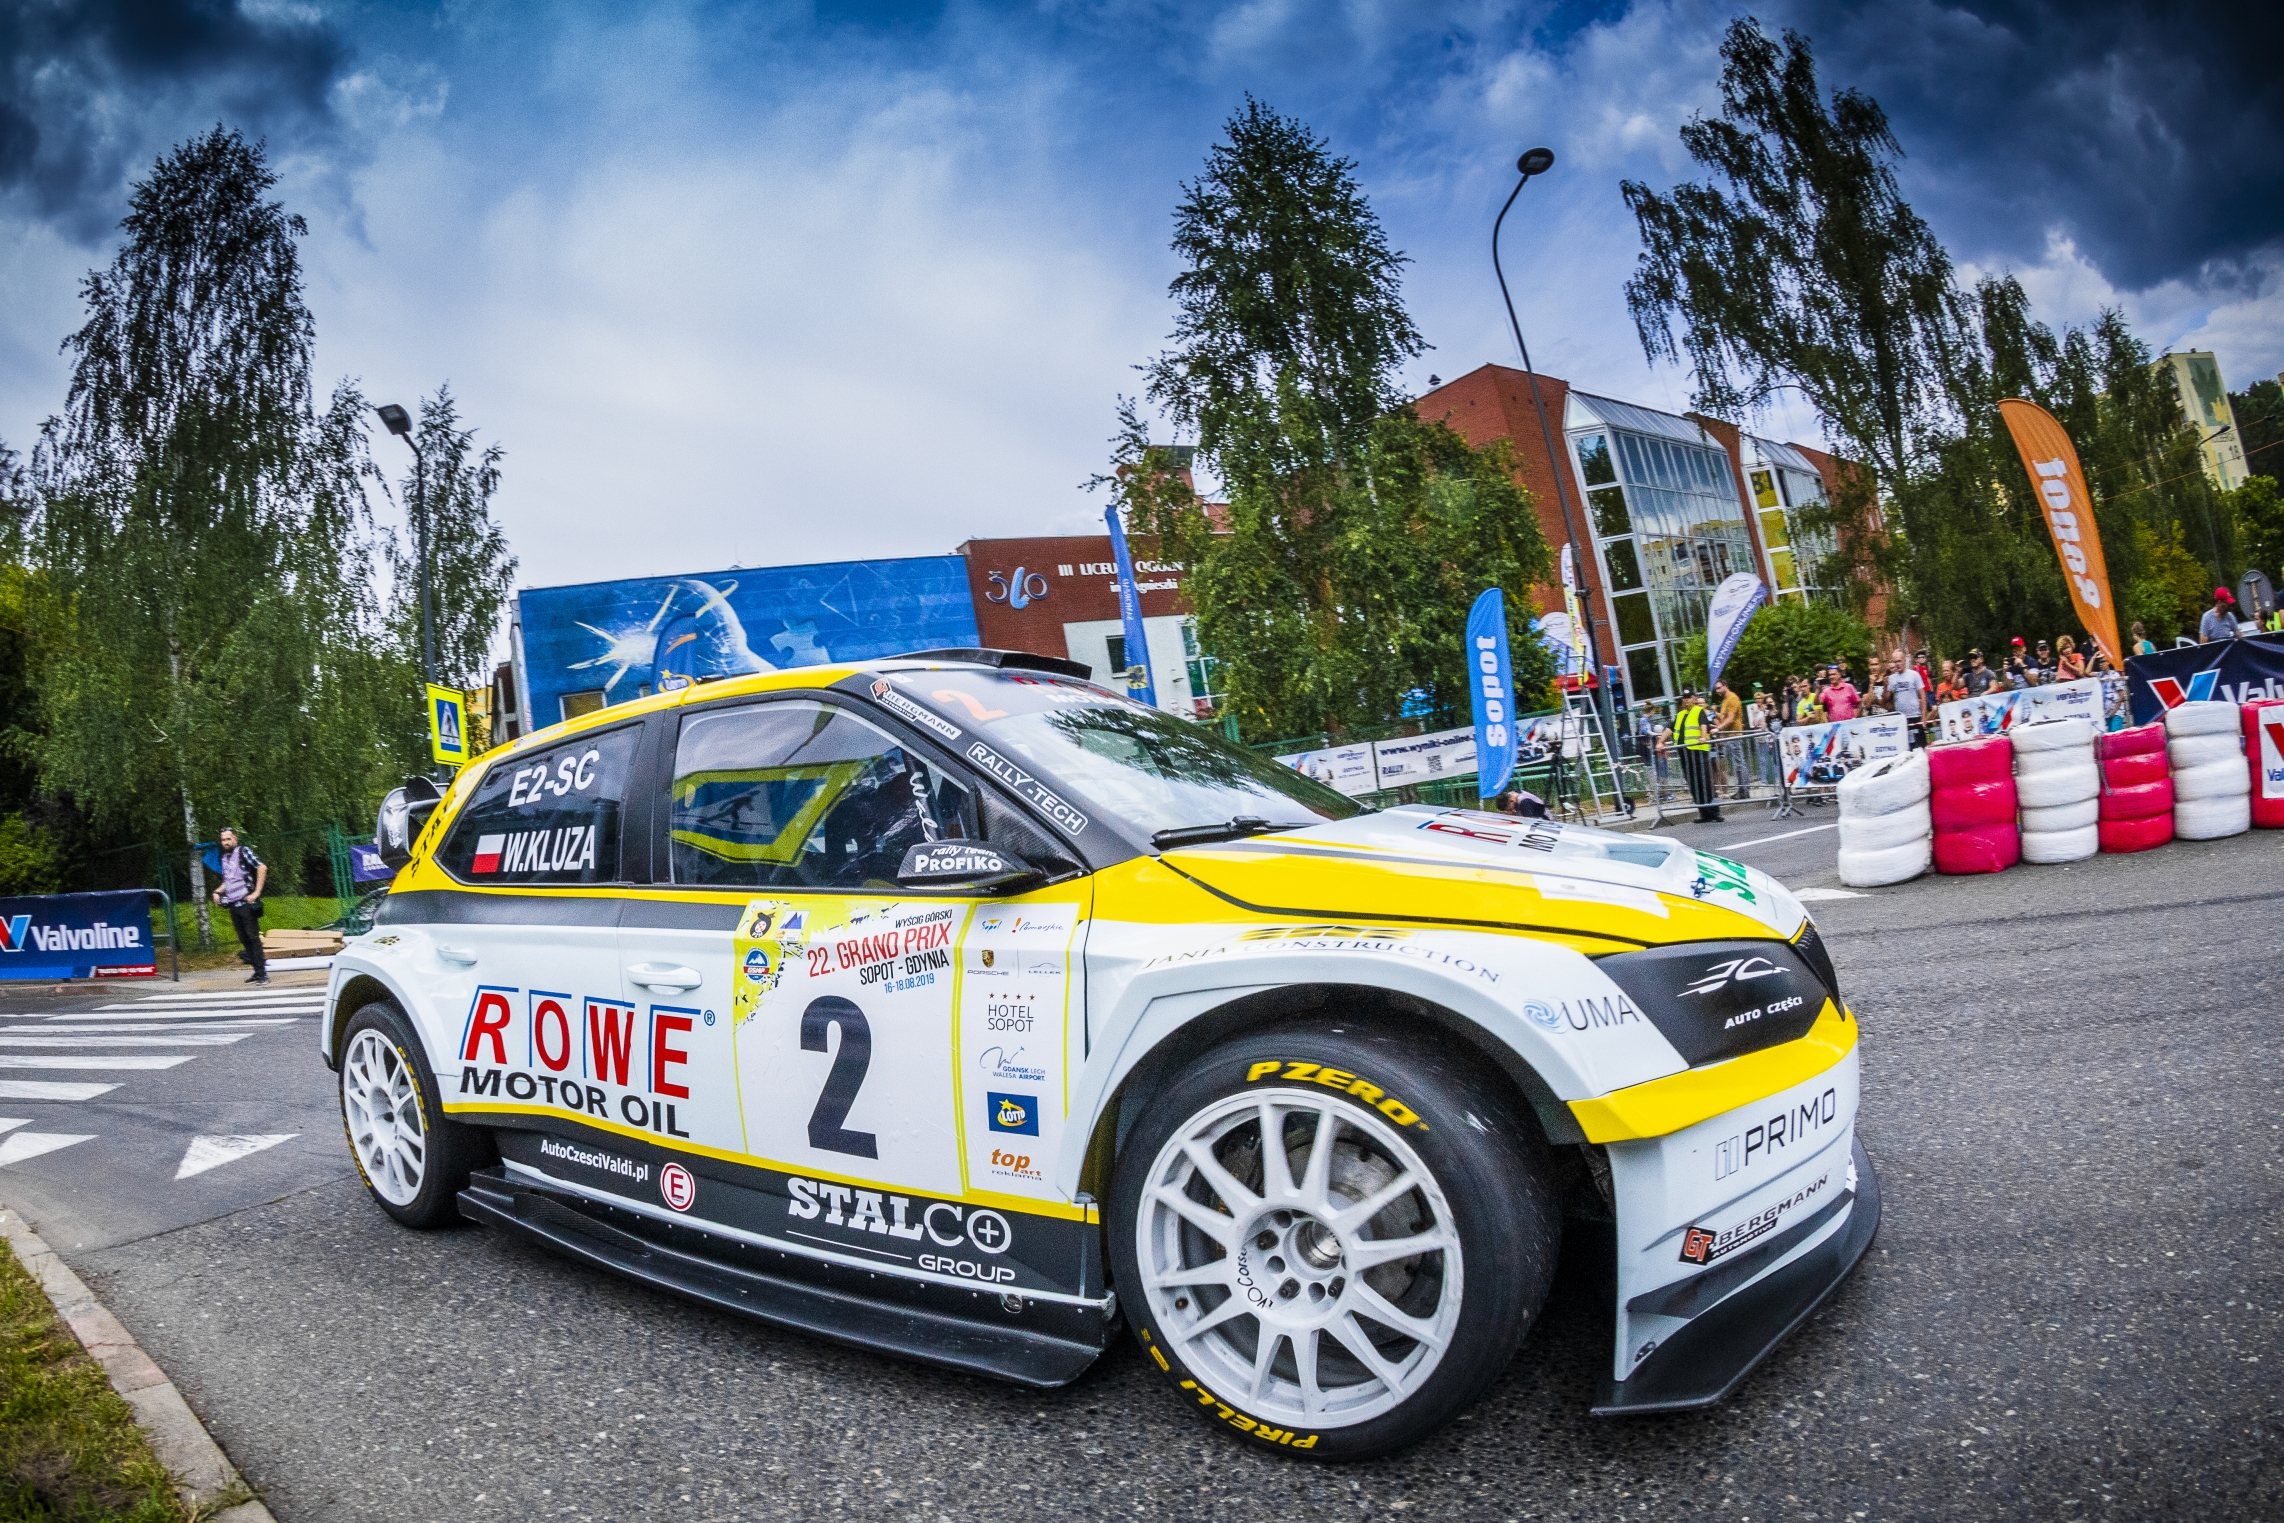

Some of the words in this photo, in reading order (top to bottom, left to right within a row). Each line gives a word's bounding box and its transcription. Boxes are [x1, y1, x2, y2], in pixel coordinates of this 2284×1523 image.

[1079, 562, 1118, 575] LICEU
[1476, 635, 1508, 748] sopot
[886, 691, 957, 738] BERGMANN
[508, 749, 600, 808] E2-SC
[503, 825, 595, 873] W.KLUZA
[931, 845, 962, 857] rally
[964, 846, 998, 857] team
[31, 922, 143, 951] Valvoline
[895, 914, 924, 928] WYŚCIG
[924, 908, 953, 924] GÓRSKI
[807, 946, 836, 978] 22.
[836, 931, 899, 970] GRAND
[903, 920, 953, 955] PRIX
[860, 961, 895, 986] SOPOT
[905, 948, 950, 976] GDYNIA
[1142, 946, 1227, 970] JANIA
[1243, 939, 1500, 983] CONSTRUCTION
[884, 972, 935, 994] 16-18.08.2019
[988, 1004, 1034, 1019] HOTEL
[988, 1017, 1034, 1033] SOPOT
[1564, 994, 1640, 1032] UMA
[1724, 1008, 1761, 1030] AUTO
[1767, 996, 1804, 1014] CZĘŚCI
[463, 991, 693, 1100] ROWE
[800, 995, 879, 1160] 2
[992, 1071, 1017, 1079] WALESA
[459, 1065, 609, 1119] MOTOR
[620, 1095, 690, 1139] OIL
[1000, 1109, 1026, 1122] LOTTO
[1744, 1087, 1836, 1166] PRIMO
[541, 1139, 649, 1182] AutoCzesciValdi.pl
[991, 1148, 1031, 1172] top
[1020, 1169, 1042, 1177] art
[991, 1170, 1042, 1181] reklama
[670, 1173, 685, 1200] E
[787, 1177, 1012, 1254] STALCO
[1683, 1228, 1713, 1262] GT
[1719, 1174, 1829, 1247] BERGMANN
[1712, 1222, 1775, 1258] AUTOMOTIVE
[918, 1254, 1016, 1283] GROUP
[1180, 1379, 1319, 1449] PIRELLI
